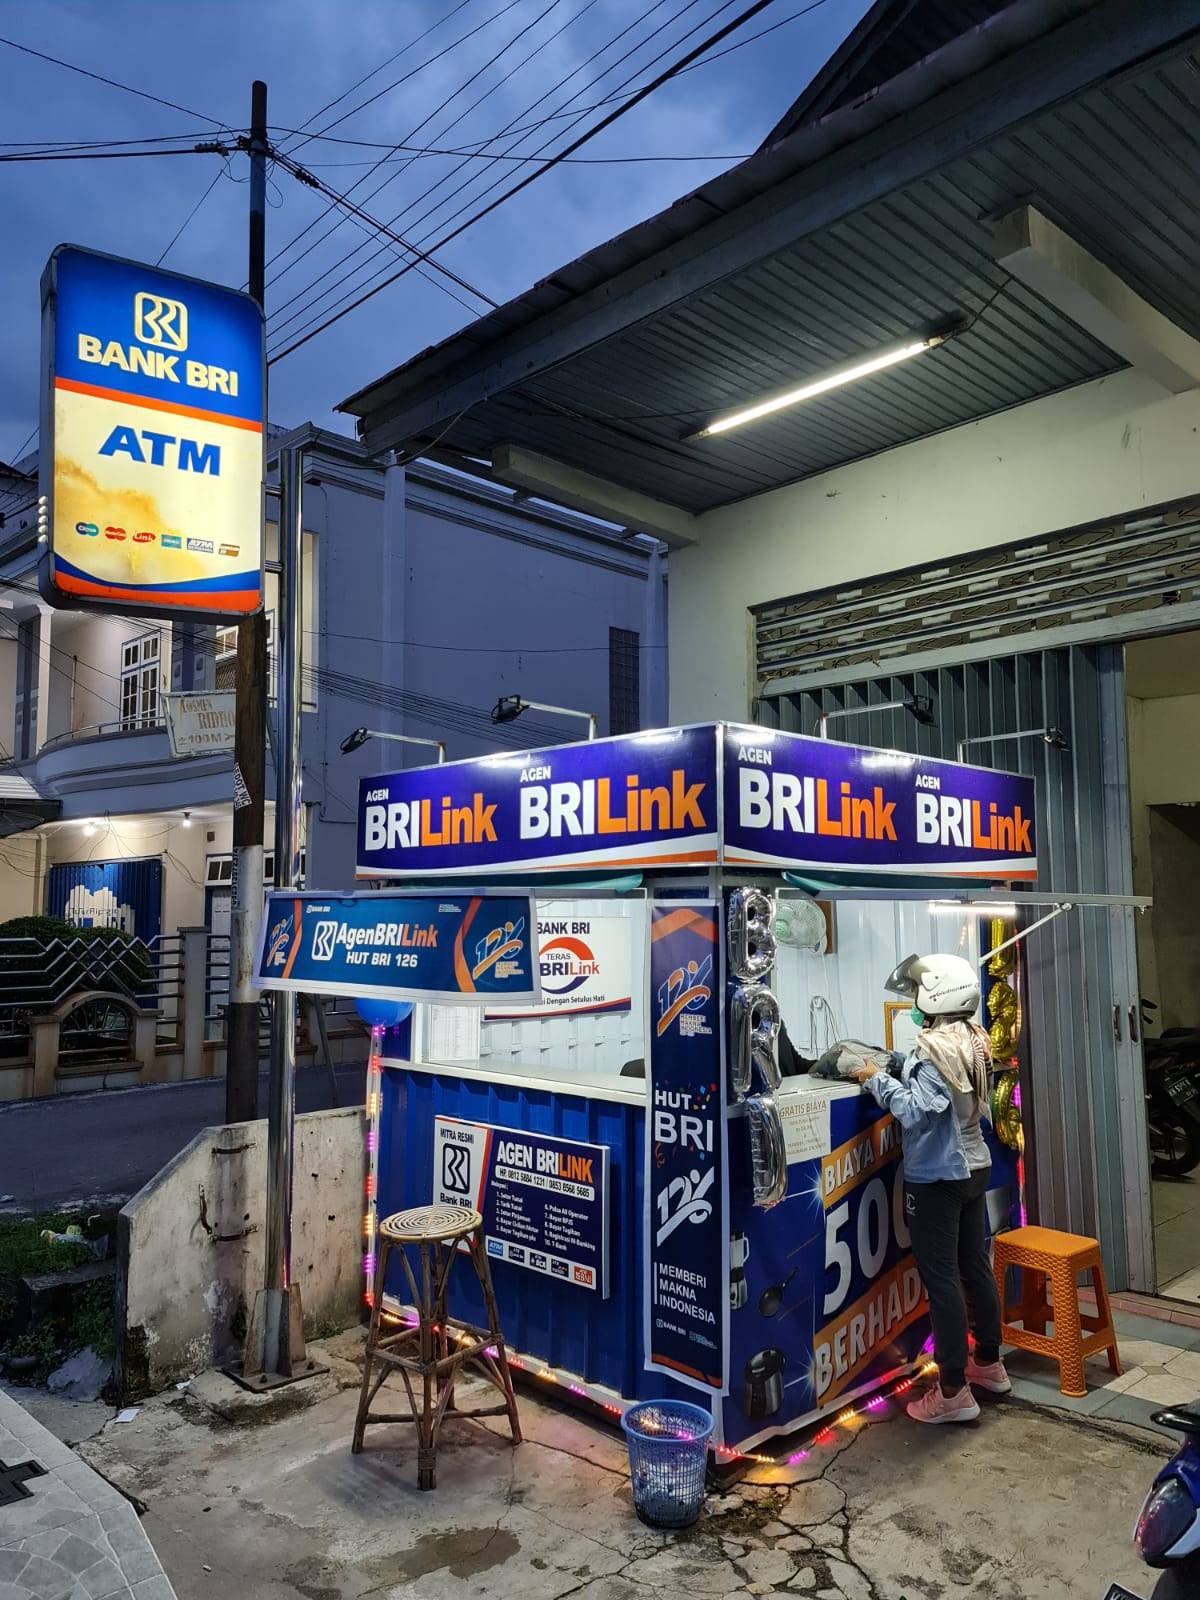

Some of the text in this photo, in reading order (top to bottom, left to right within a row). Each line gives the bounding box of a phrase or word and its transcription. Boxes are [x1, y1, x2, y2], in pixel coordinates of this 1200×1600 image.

[78, 333, 239, 397] BANK BRI
[98, 424, 221, 477] ATM
[738, 746, 773, 766] AGEN
[520, 765, 552, 784] AGEN
[915, 774, 941, 791] AGEN
[366, 788, 390, 803] AGEN
[519, 769, 707, 840] BRILink
[739, 767, 898, 842] BRILink
[365, 792, 498, 852] BRILink
[915, 791, 1033, 854] BRILink
[336, 922, 439, 950] AgenBRILink
[537, 921, 591, 935] BANK BRI
[346, 951, 419, 968] HUT BRI 126
[546, 953, 572, 961] TERAS
[540, 961, 600, 977] BRILink
[546, 996, 570, 1007] Dengan
[571, 994, 592, 1004] Setulus
[593, 993, 605, 1002] Hati
[655, 1088, 693, 1111] HUT
[806, 1099, 827, 1113] BIAYA
[440, 1127, 475, 1145] MITRA RESMI
[654, 1110, 714, 1153] BRI
[497, 1140, 594, 1184] AGEN BRILINK
[825, 1135, 875, 1197] BIAYA
[440, 1192, 473, 1209] Bank BRI
[659, 1262, 707, 1289] MEMBERI
[659, 1278, 697, 1301] MAKNA
[659, 1294, 716, 1325] INDONESIA
[815, 1266, 929, 1399] BERHAD
